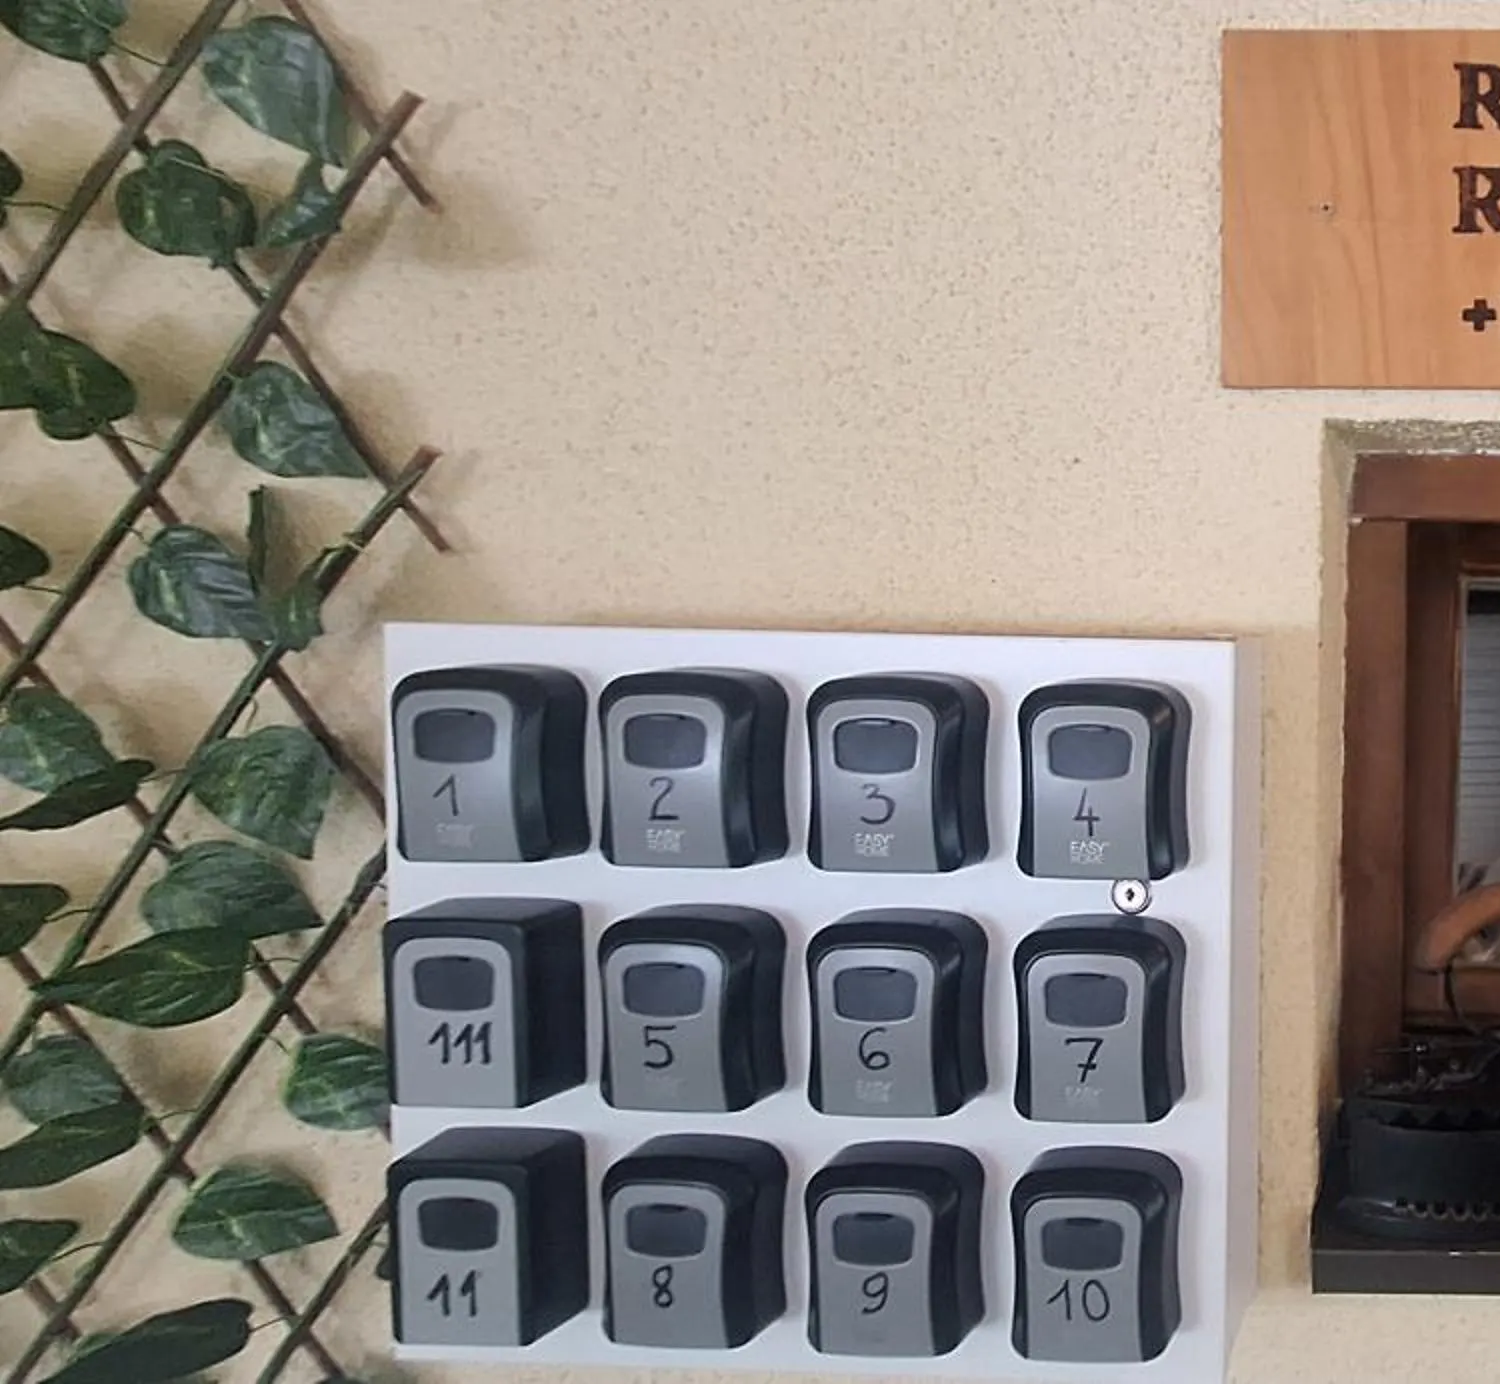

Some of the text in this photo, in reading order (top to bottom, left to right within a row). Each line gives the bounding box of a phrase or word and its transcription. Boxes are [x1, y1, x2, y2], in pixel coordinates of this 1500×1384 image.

[432, 773, 460, 817] 1
[648, 775, 681, 821] 2
[859, 782, 896, 825] 3
[1072, 787, 1101, 837] 4
[428, 1020, 493, 1066] 111
[642, 1024, 677, 1070] 5
[858, 1026, 891, 1071] 6
[1063, 1036, 1105, 1083] 7
[426, 1268, 482, 1318] 11
[651, 1264, 674, 1309] 8
[861, 1271, 890, 1316] 9
[1046, 1278, 1111, 1322] 10
